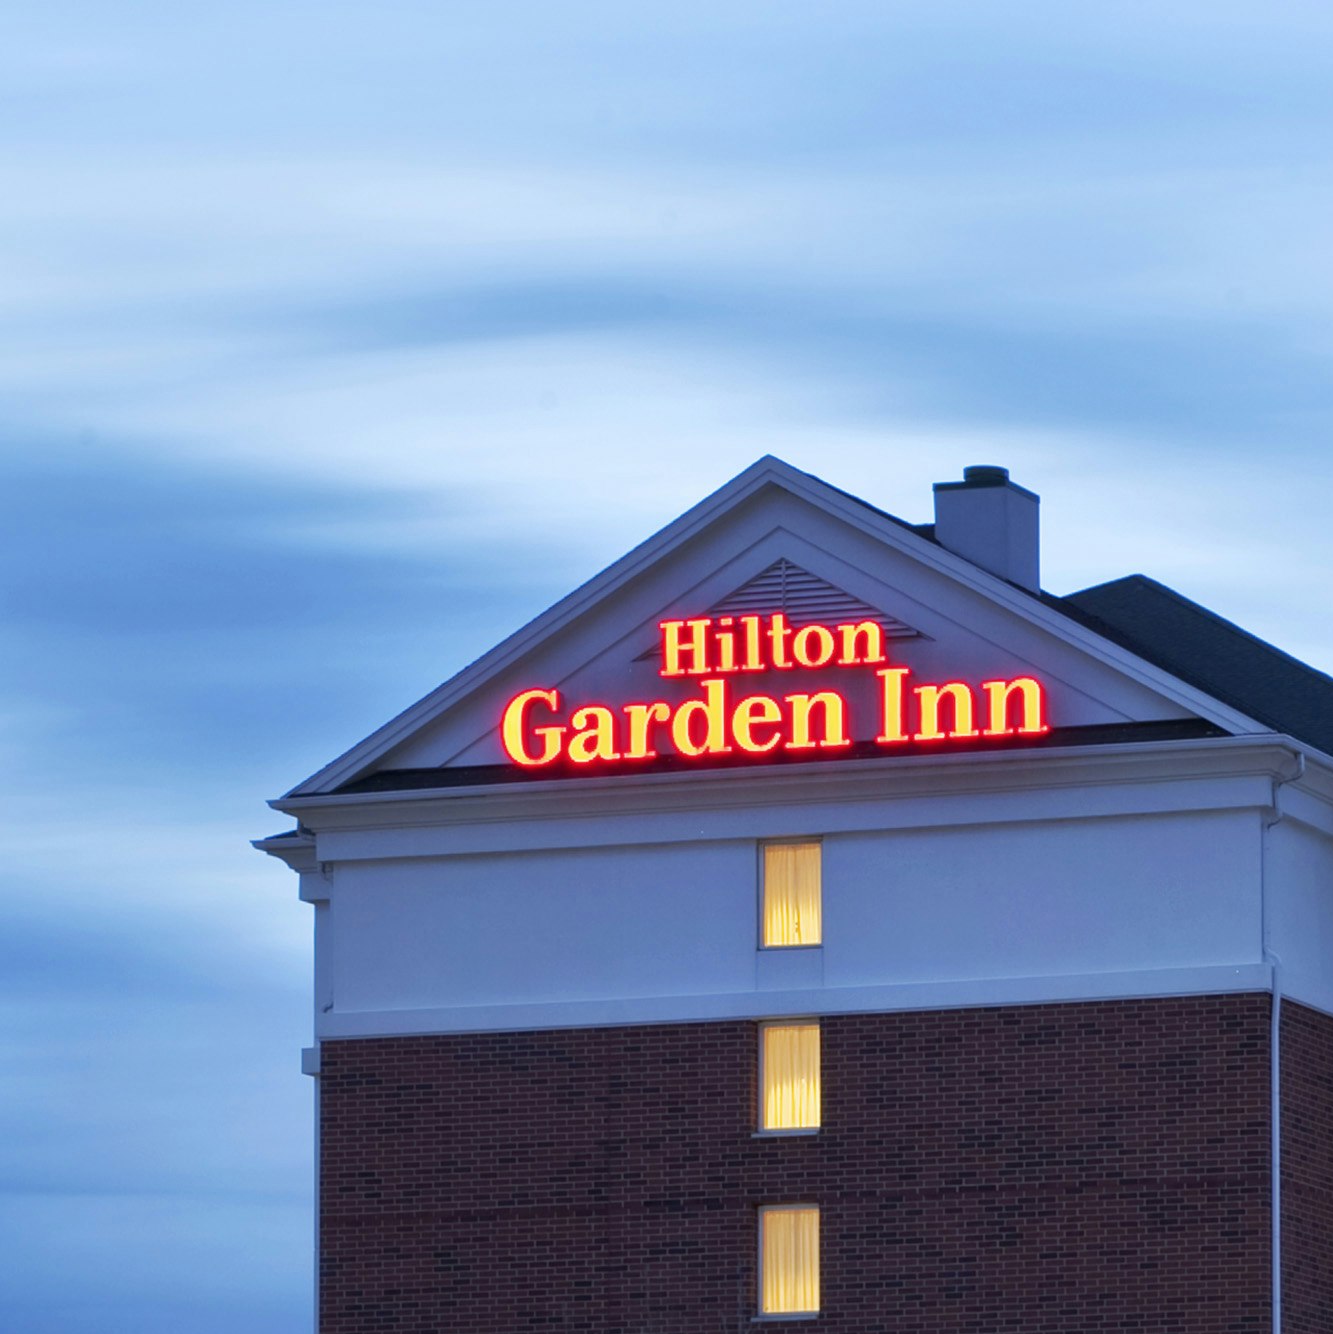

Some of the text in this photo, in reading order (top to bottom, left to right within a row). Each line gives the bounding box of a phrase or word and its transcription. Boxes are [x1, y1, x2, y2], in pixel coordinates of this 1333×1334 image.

[659, 612, 887, 677] Hilton
[501, 666, 1050, 767] Garden Inn
